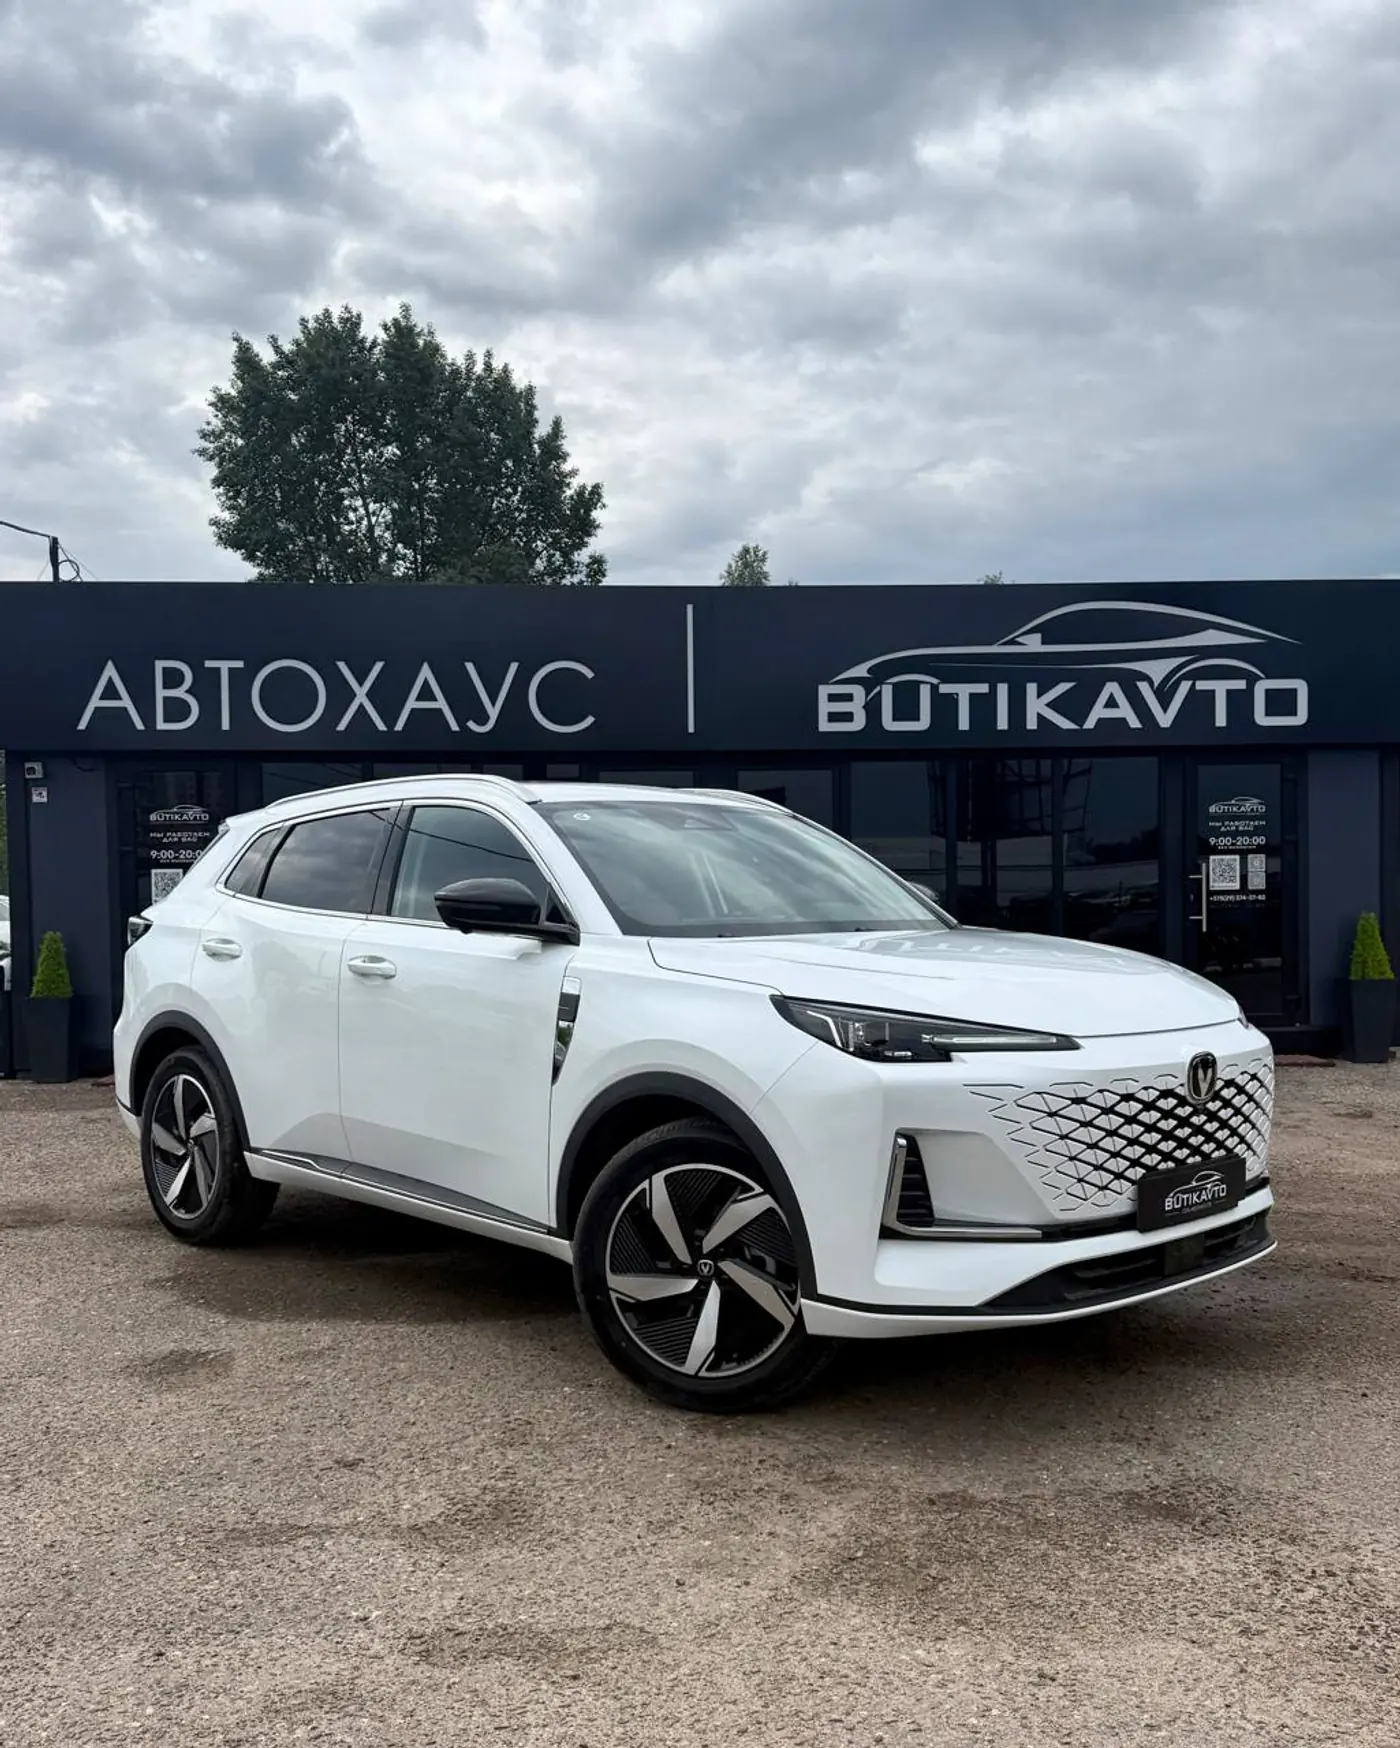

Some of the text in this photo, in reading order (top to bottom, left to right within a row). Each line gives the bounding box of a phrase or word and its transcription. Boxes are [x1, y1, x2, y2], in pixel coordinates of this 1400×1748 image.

[77, 658, 597, 735] АВТОХАУС
[817, 678, 1309, 733] BUTIKAVTO
[1209, 804, 1266, 813] BUTIKAVTO
[150, 813, 209, 821] BUTIKAVTO
[1209, 836, 1266, 846] 9:00-20:00
[150, 849, 204, 859] 9:00-20:0
[1165, 1184, 1227, 1211] BUTIKAVTO
